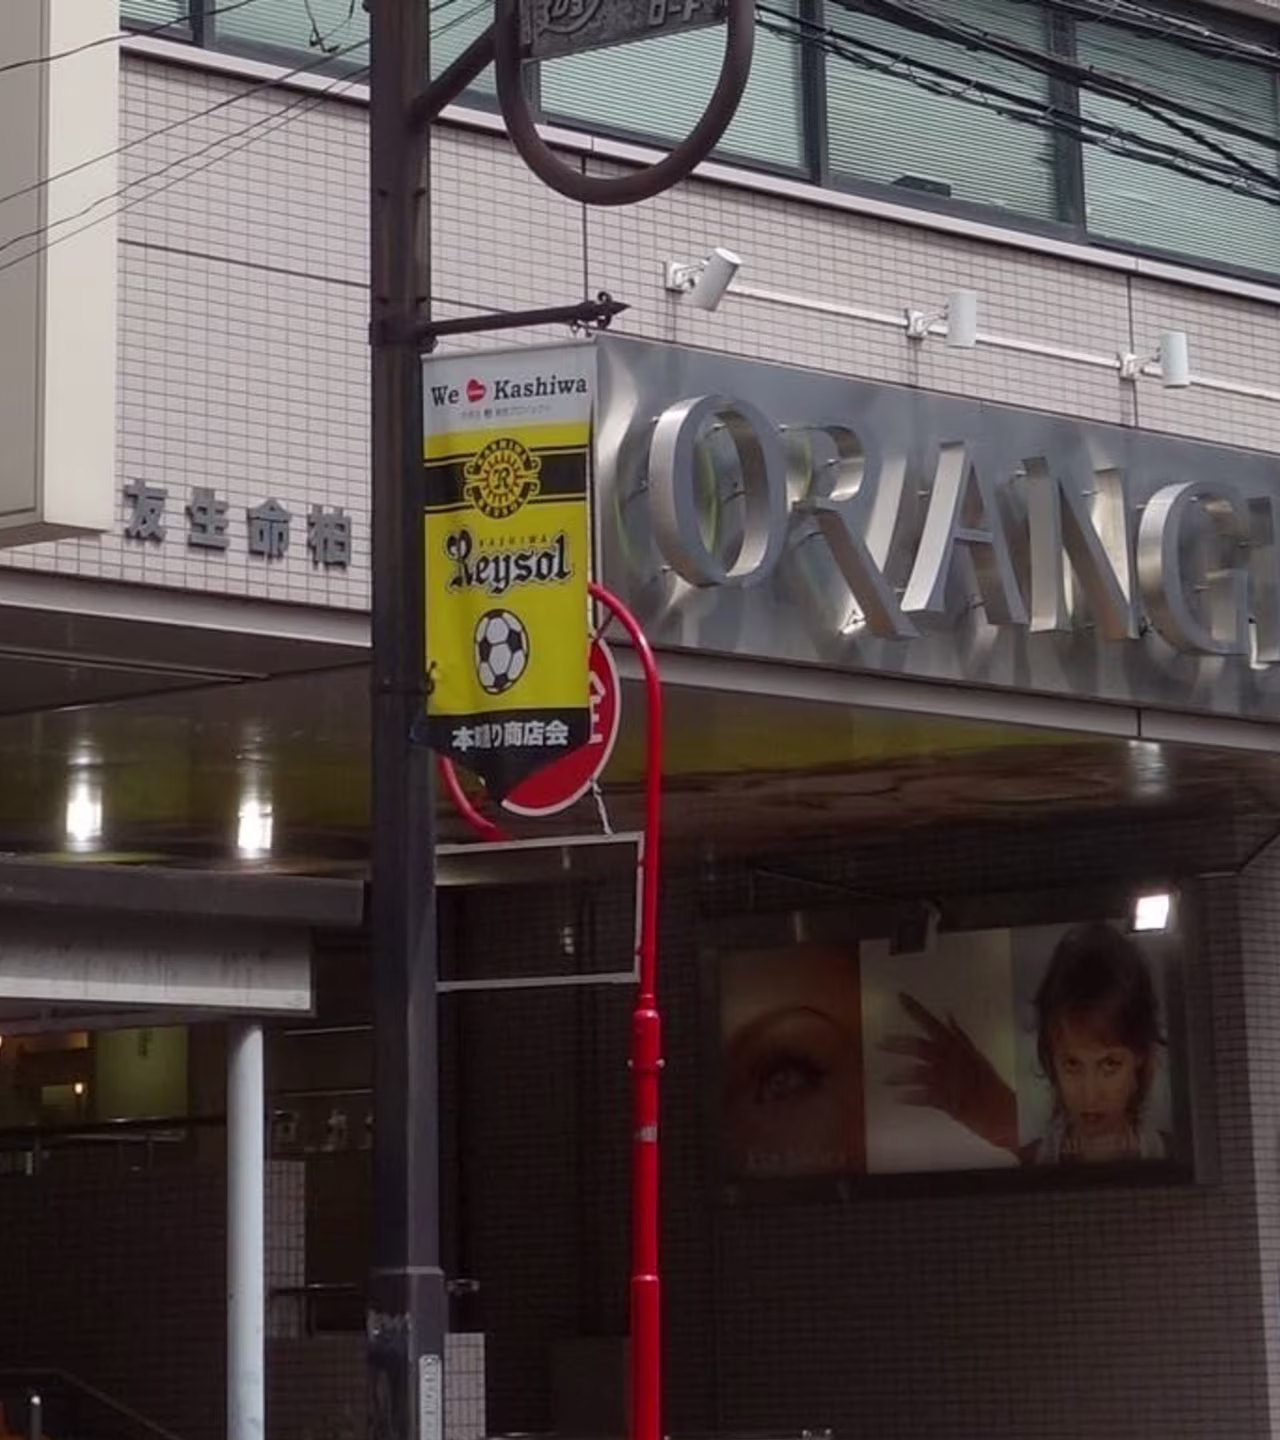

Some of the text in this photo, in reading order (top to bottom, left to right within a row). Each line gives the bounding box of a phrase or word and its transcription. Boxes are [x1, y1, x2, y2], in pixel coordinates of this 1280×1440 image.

[431, 375, 588, 406] We Kashiwa
[446, 530, 574, 594] Reysol
